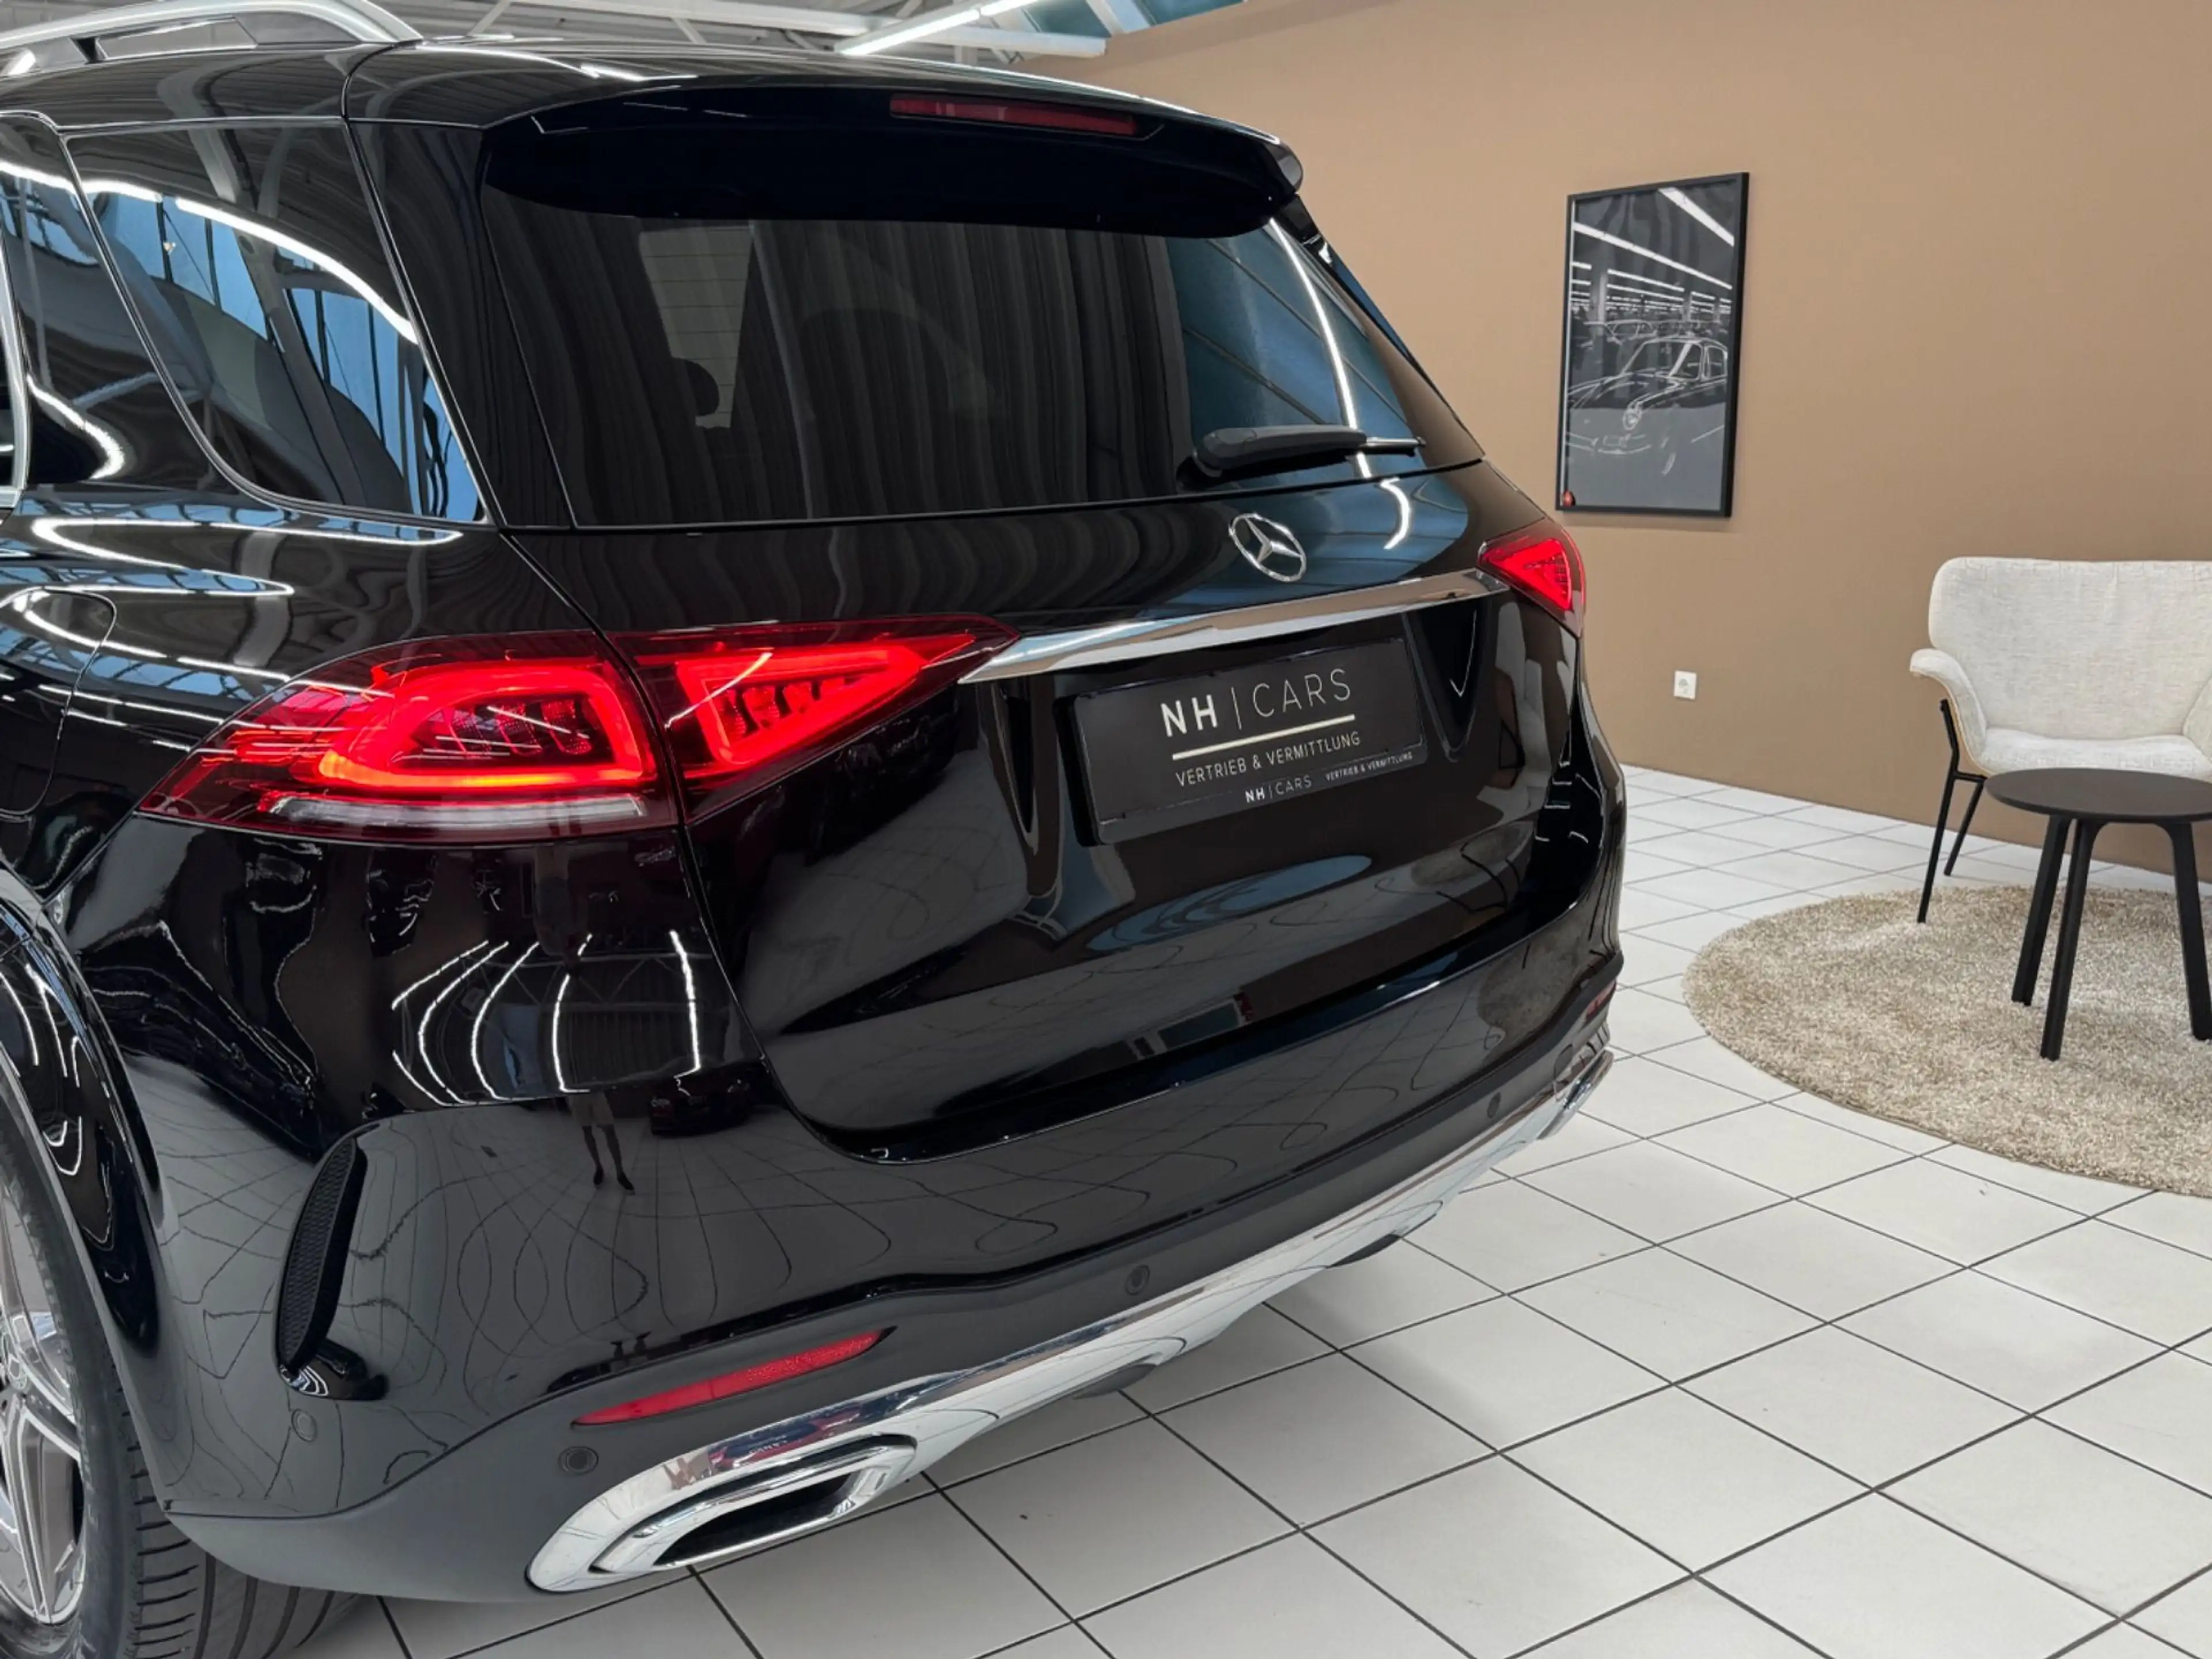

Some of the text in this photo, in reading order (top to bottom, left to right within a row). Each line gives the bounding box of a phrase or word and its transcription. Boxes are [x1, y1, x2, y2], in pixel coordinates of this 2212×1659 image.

[1160, 668, 1351, 737] NH CARS
[1175, 730, 1361, 787] VERTRIEB & VERMITTLUNG
[1245, 787, 1266, 803] NH
[1275, 775, 1312, 796] CARS
